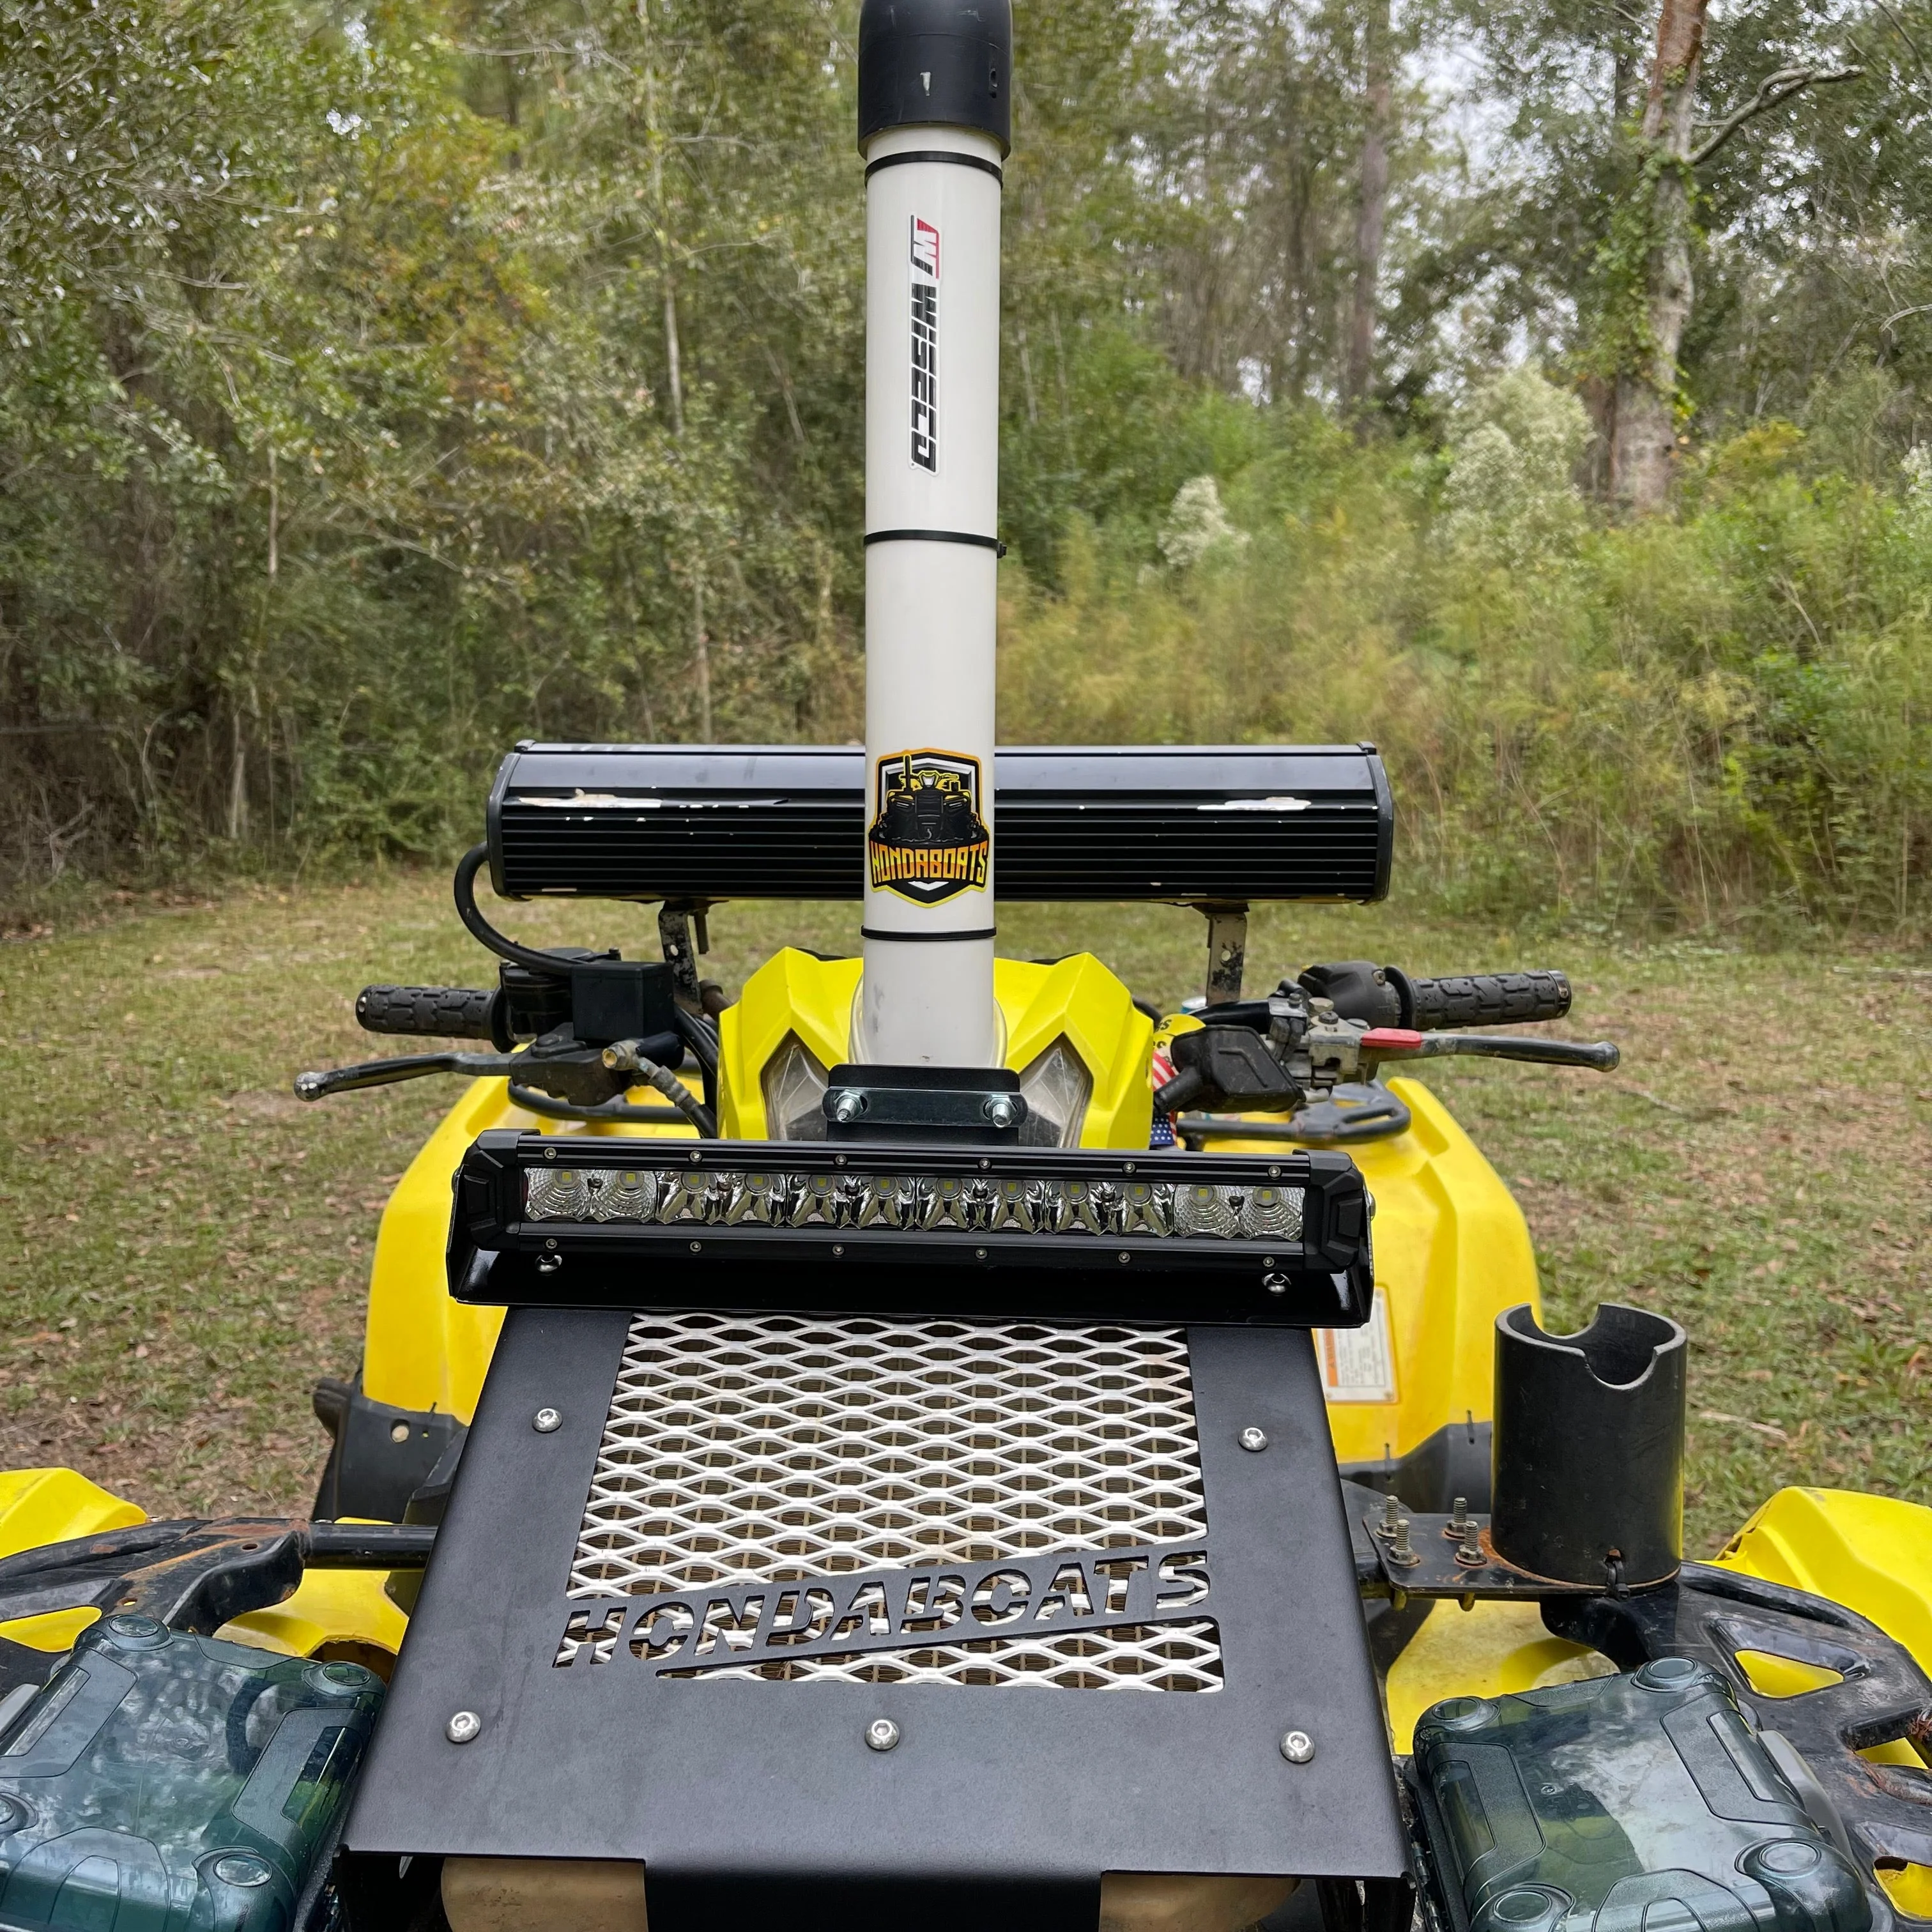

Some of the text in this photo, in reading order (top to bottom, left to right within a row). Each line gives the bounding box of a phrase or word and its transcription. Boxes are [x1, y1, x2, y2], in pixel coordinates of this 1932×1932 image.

[911, 282, 937, 472] WISECO
[870, 839, 988, 884] HONDABOATS
[553, 1550, 1209, 1668] HONDABOATS
